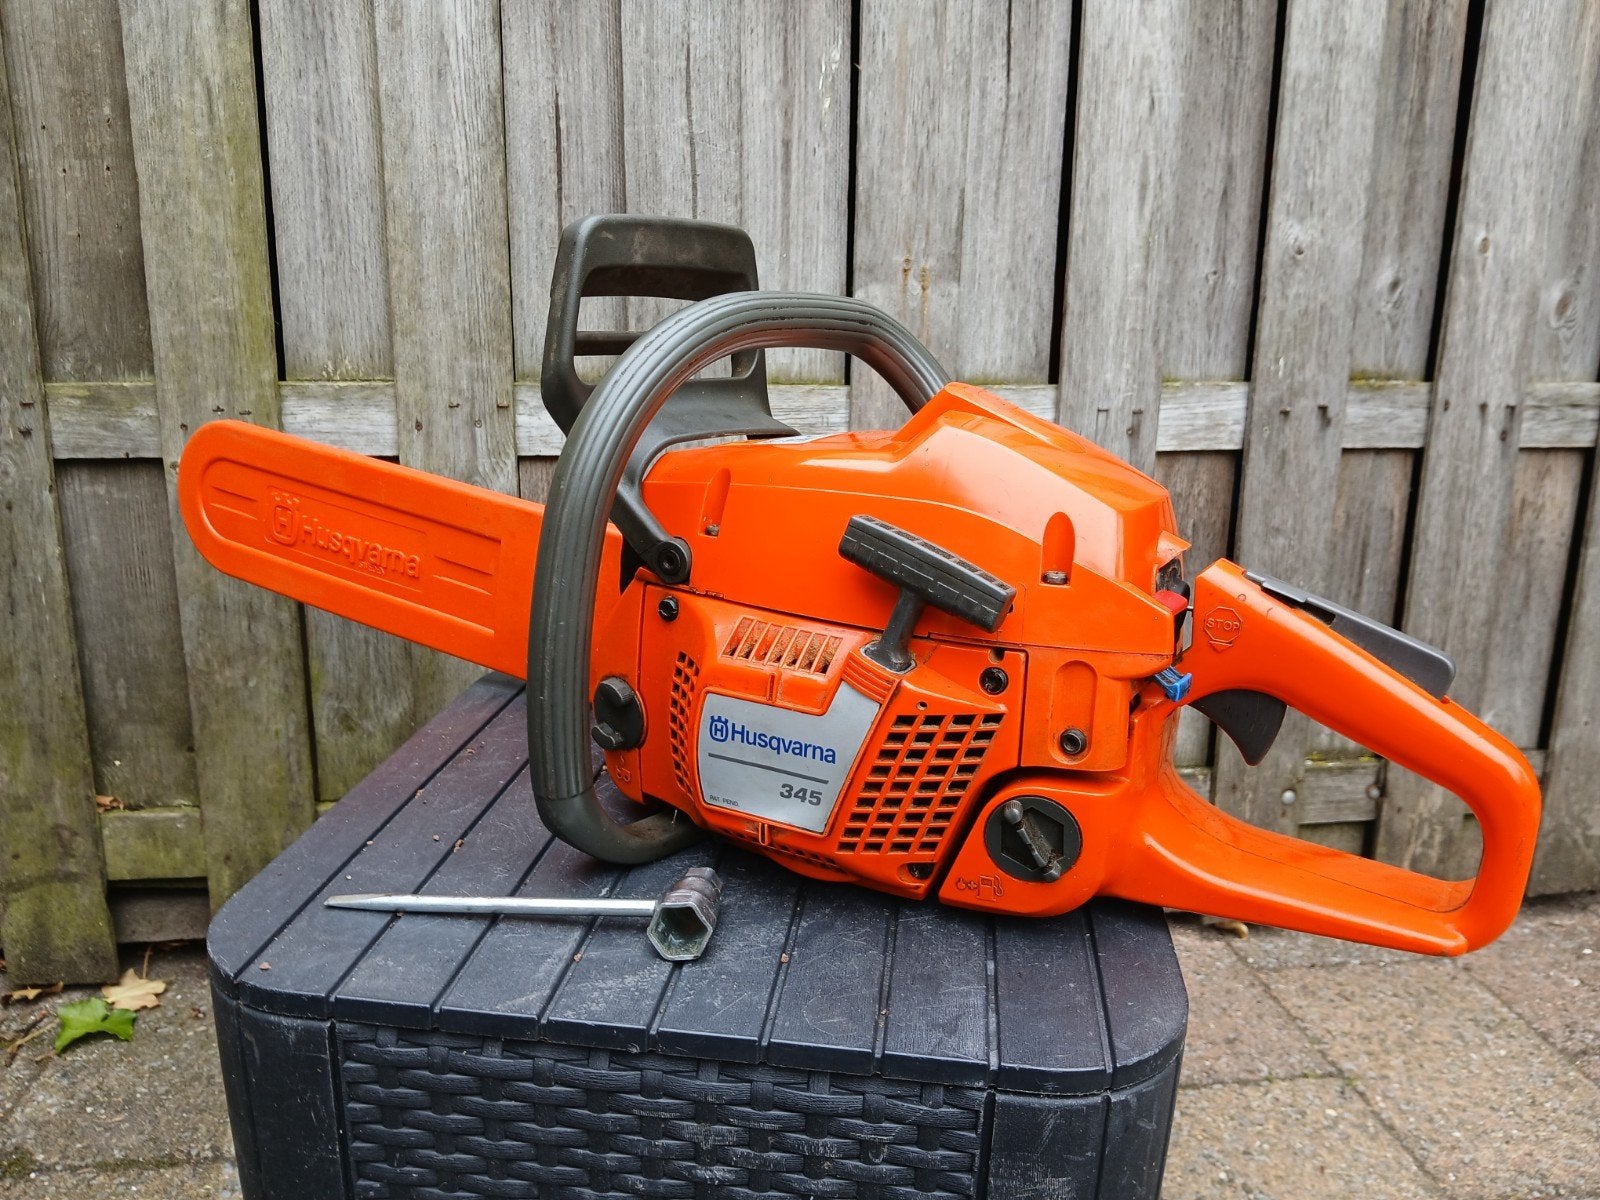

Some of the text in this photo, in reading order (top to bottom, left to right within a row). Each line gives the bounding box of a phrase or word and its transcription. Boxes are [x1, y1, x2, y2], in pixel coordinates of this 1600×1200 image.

[302, 515, 421, 578] Husqvarna
[1206, 617, 1240, 631] STOP
[731, 722, 836, 765] Husqvarna
[779, 783, 823, 806] 345
